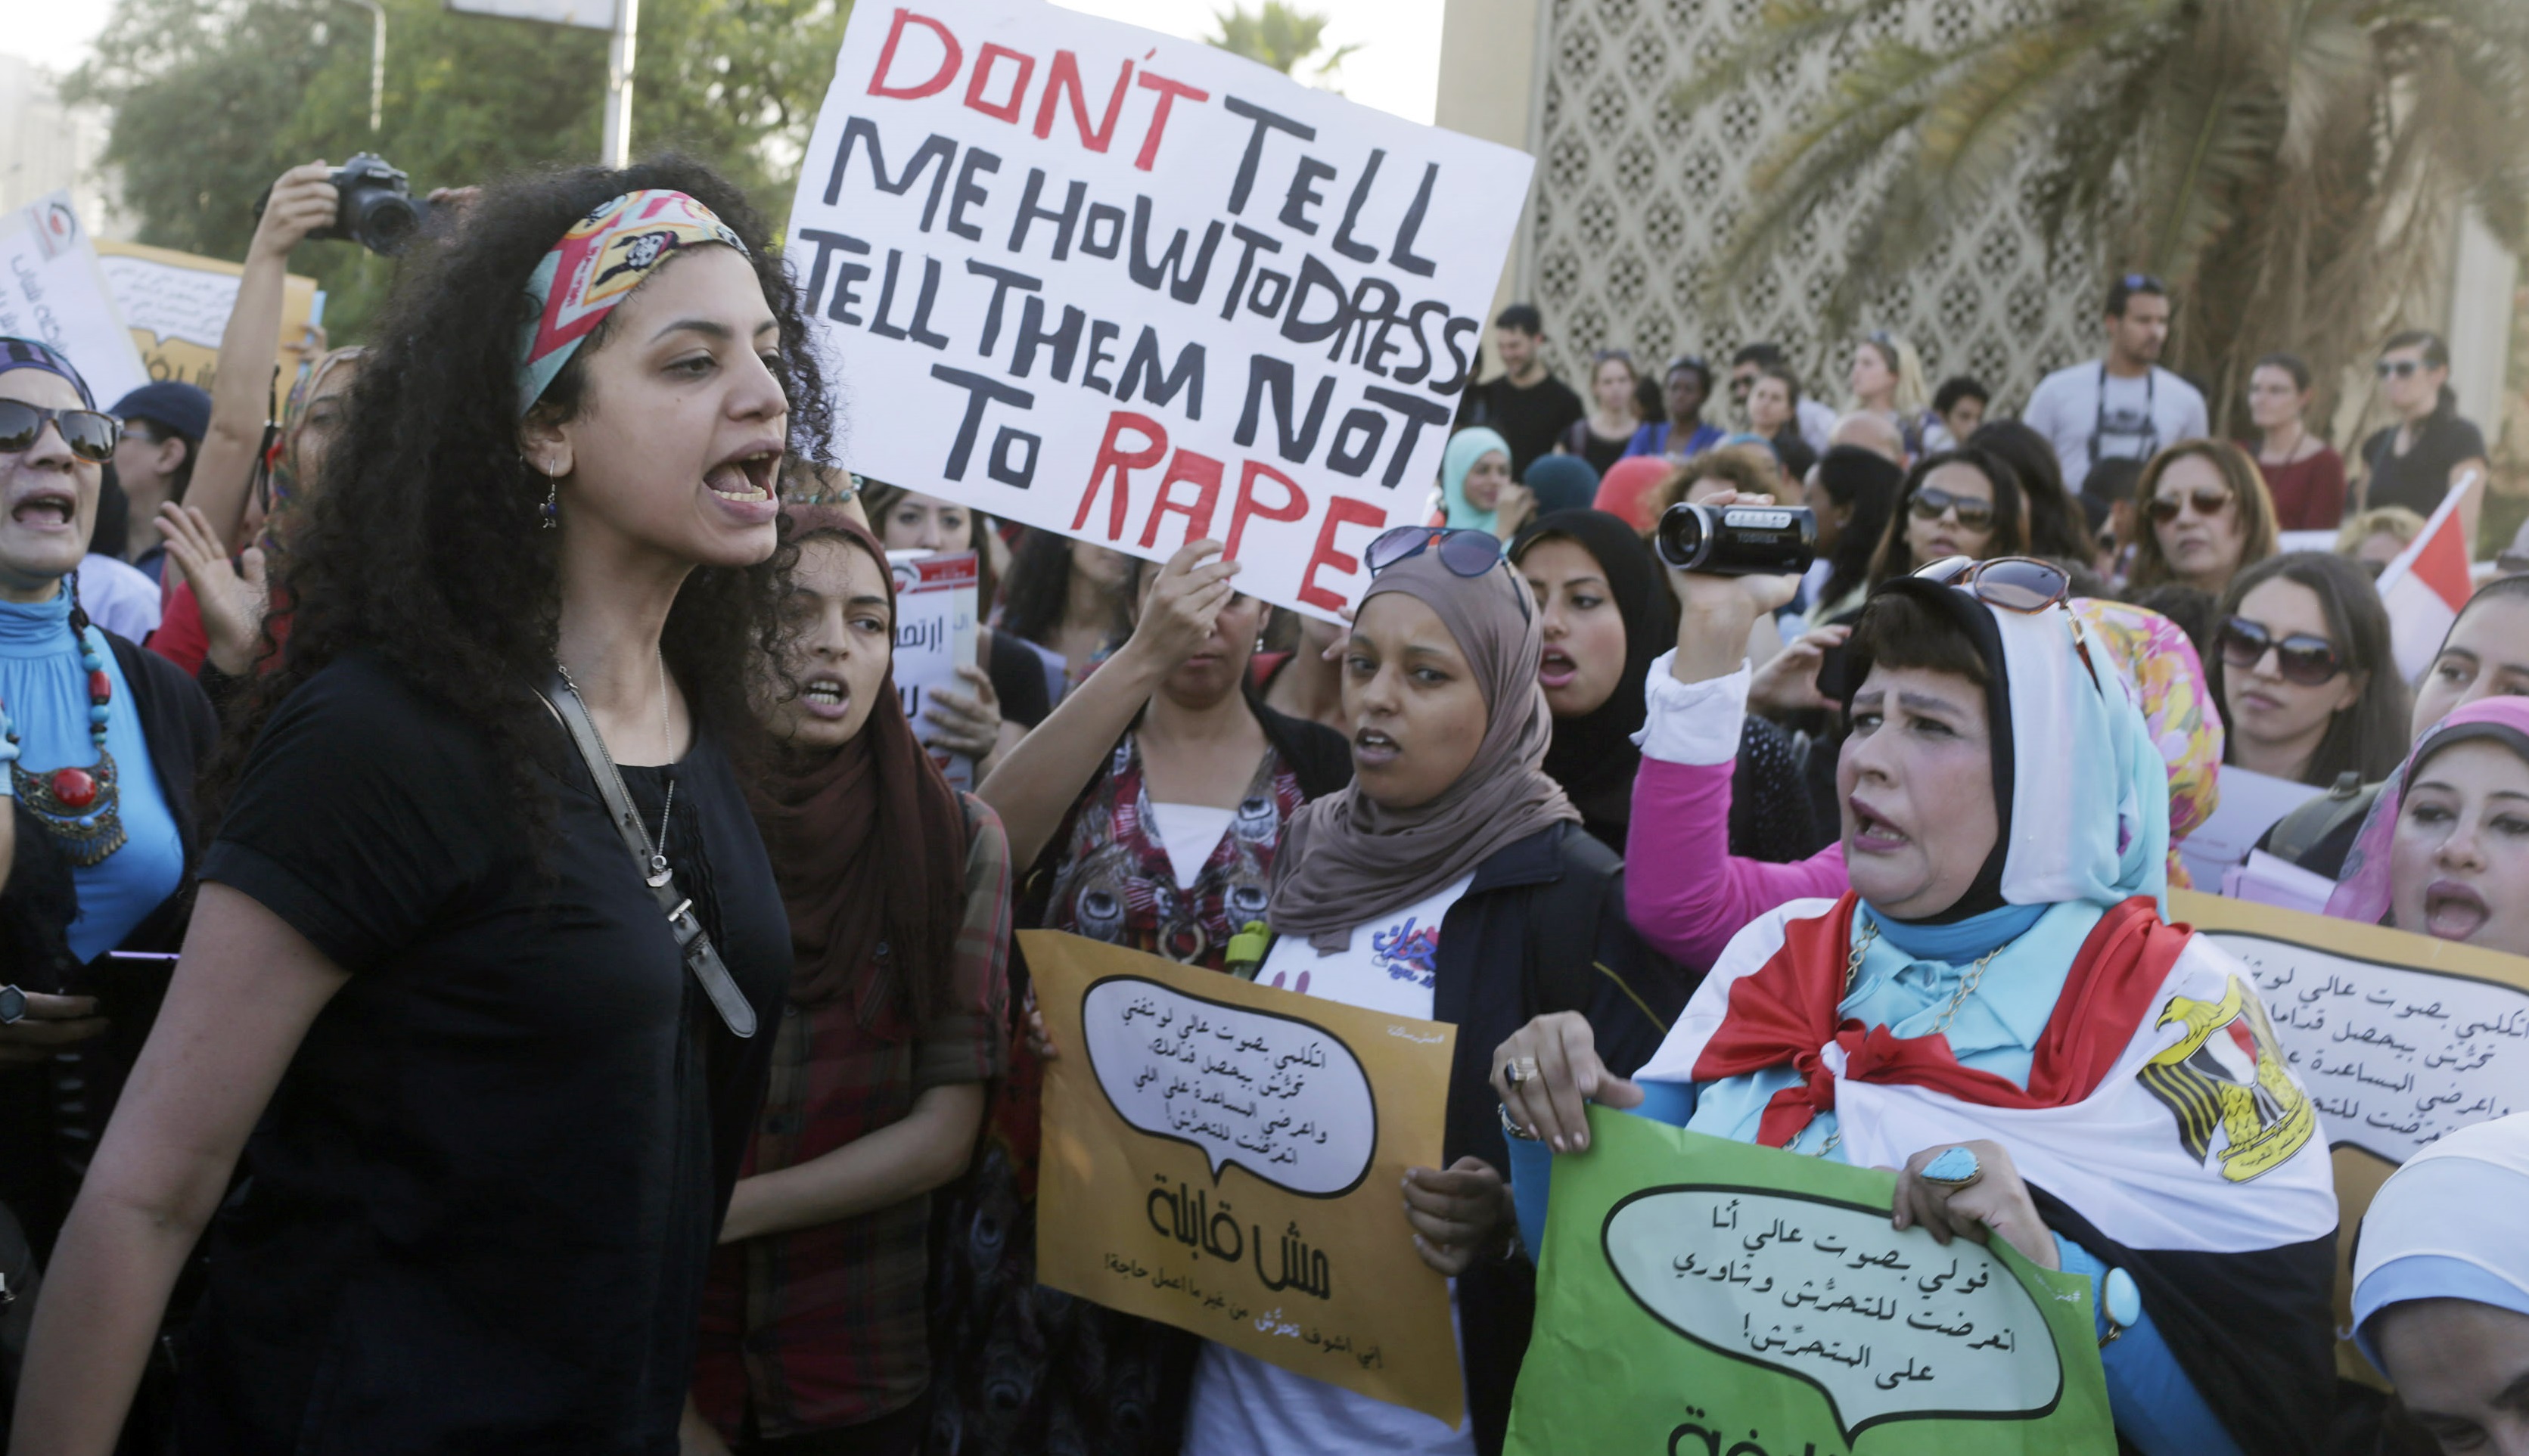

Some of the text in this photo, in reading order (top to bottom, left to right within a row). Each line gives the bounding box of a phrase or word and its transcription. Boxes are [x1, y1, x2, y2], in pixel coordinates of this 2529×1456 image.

[1224, 95, 1440, 278] TELL
[823, 116, 1002, 243] ME
[1280, 253, 1479, 396] DRESS
[799, 228, 949, 350] TELL
[966, 257, 1206, 421] THEM
[1070, 411, 1387, 612] RAPE
[2263, 967, 2294, 989] لو
[2299, 975, 2356, 1009] عالي
[1156, 1007, 1173, 1028] لو
[2366, 989, 2450, 1029] بصوت
[1177, 1014, 1210, 1045] عالي
[1215, 1026, 1269, 1061] بصوت
[2332, 1021, 2416, 1062] بيحصل
[1133, 1064, 1159, 1094] اللي
[1162, 1076, 1190, 1100] على
[1201, 1054, 1254, 1091] بيحصل
[2310, 1049, 2415, 1094] المساعدة
[1194, 1079, 1258, 1118] المساعدة
[1712, 1198, 1740, 1231] أنا
[1147, 1173, 1331, 1300] مش قابلة
[1743, 1218, 1804, 1258] عالي
[1673, 1253, 1773, 1293] وشاوري
[1813, 1235, 1912, 1282] بصوت
[1918, 1258, 1989, 1299] قولي
[1203, 1290, 1226, 1309] غير
[1229, 1302, 1249, 1321] من
[1875, 1356, 1935, 1390] على
